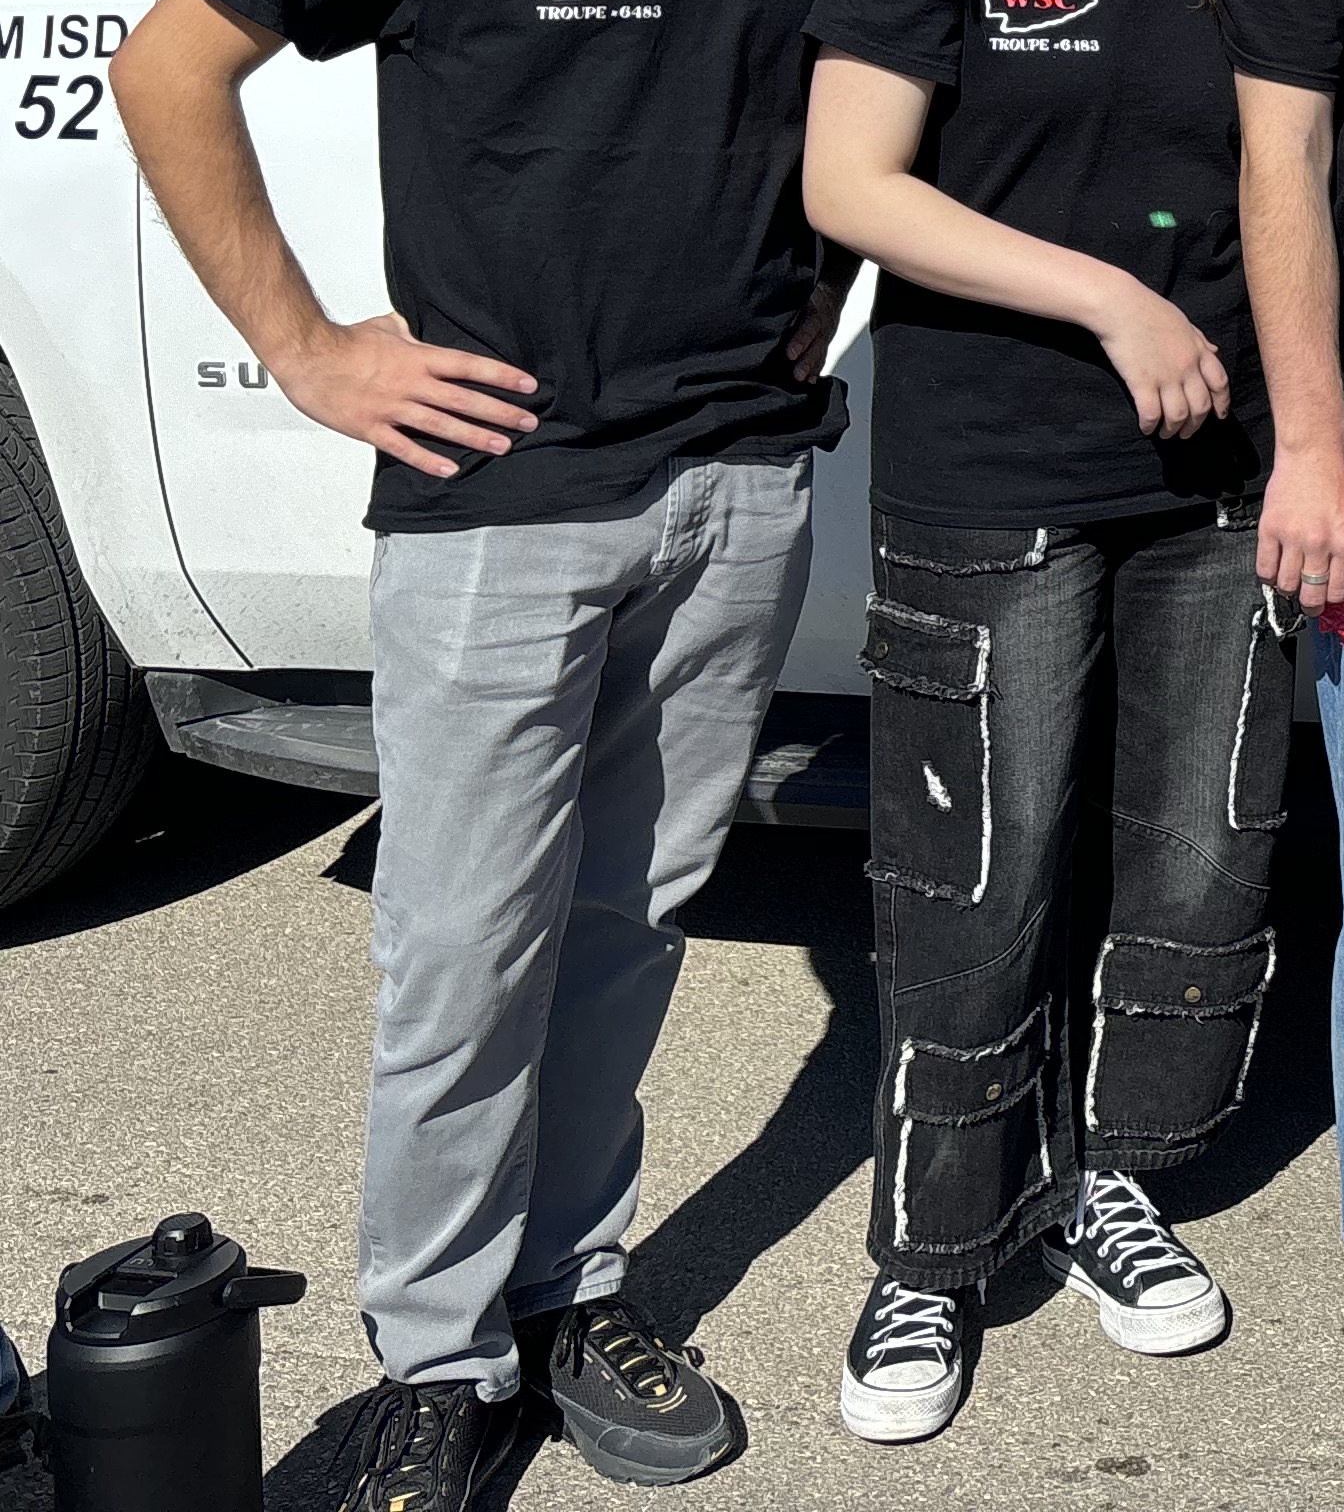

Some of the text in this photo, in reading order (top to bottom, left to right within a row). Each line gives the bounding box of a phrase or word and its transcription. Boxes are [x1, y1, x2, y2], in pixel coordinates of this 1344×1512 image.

[536, 5, 607, 20] TROUPE
[43, 14, 129, 59] ISD
[989, 38, 1049, 51] TROUPE
[15, 74, 104, 140] 52
